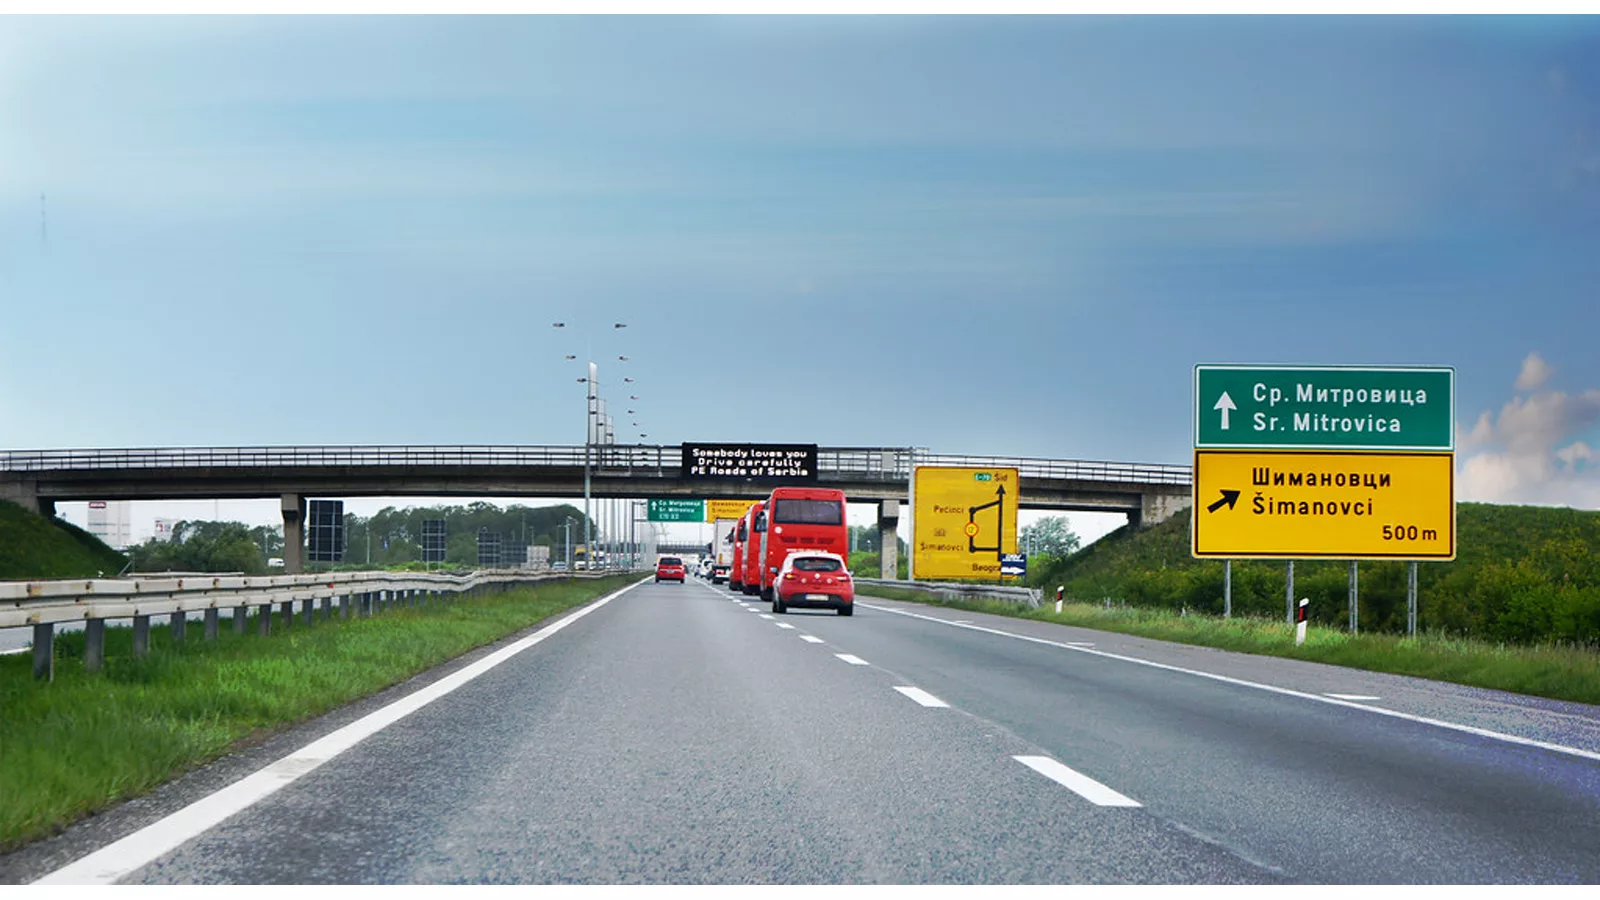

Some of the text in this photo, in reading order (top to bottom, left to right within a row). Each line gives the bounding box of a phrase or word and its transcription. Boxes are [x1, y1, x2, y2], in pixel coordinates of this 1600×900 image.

[1252, 382, 1428, 406] Ср. Митровица
[1252, 412, 1401, 432] Sr. Mitrovica
[692, 448, 748, 458] Somebody
[751, 449, 783, 458] loves
[698, 458, 802, 468] Drive carefully
[750, 467, 764, 476] of
[767, 467, 808, 476] Serbia
[1252, 467, 1392, 490] Шимановци
[1252, 492, 1373, 516] Šimanovci
